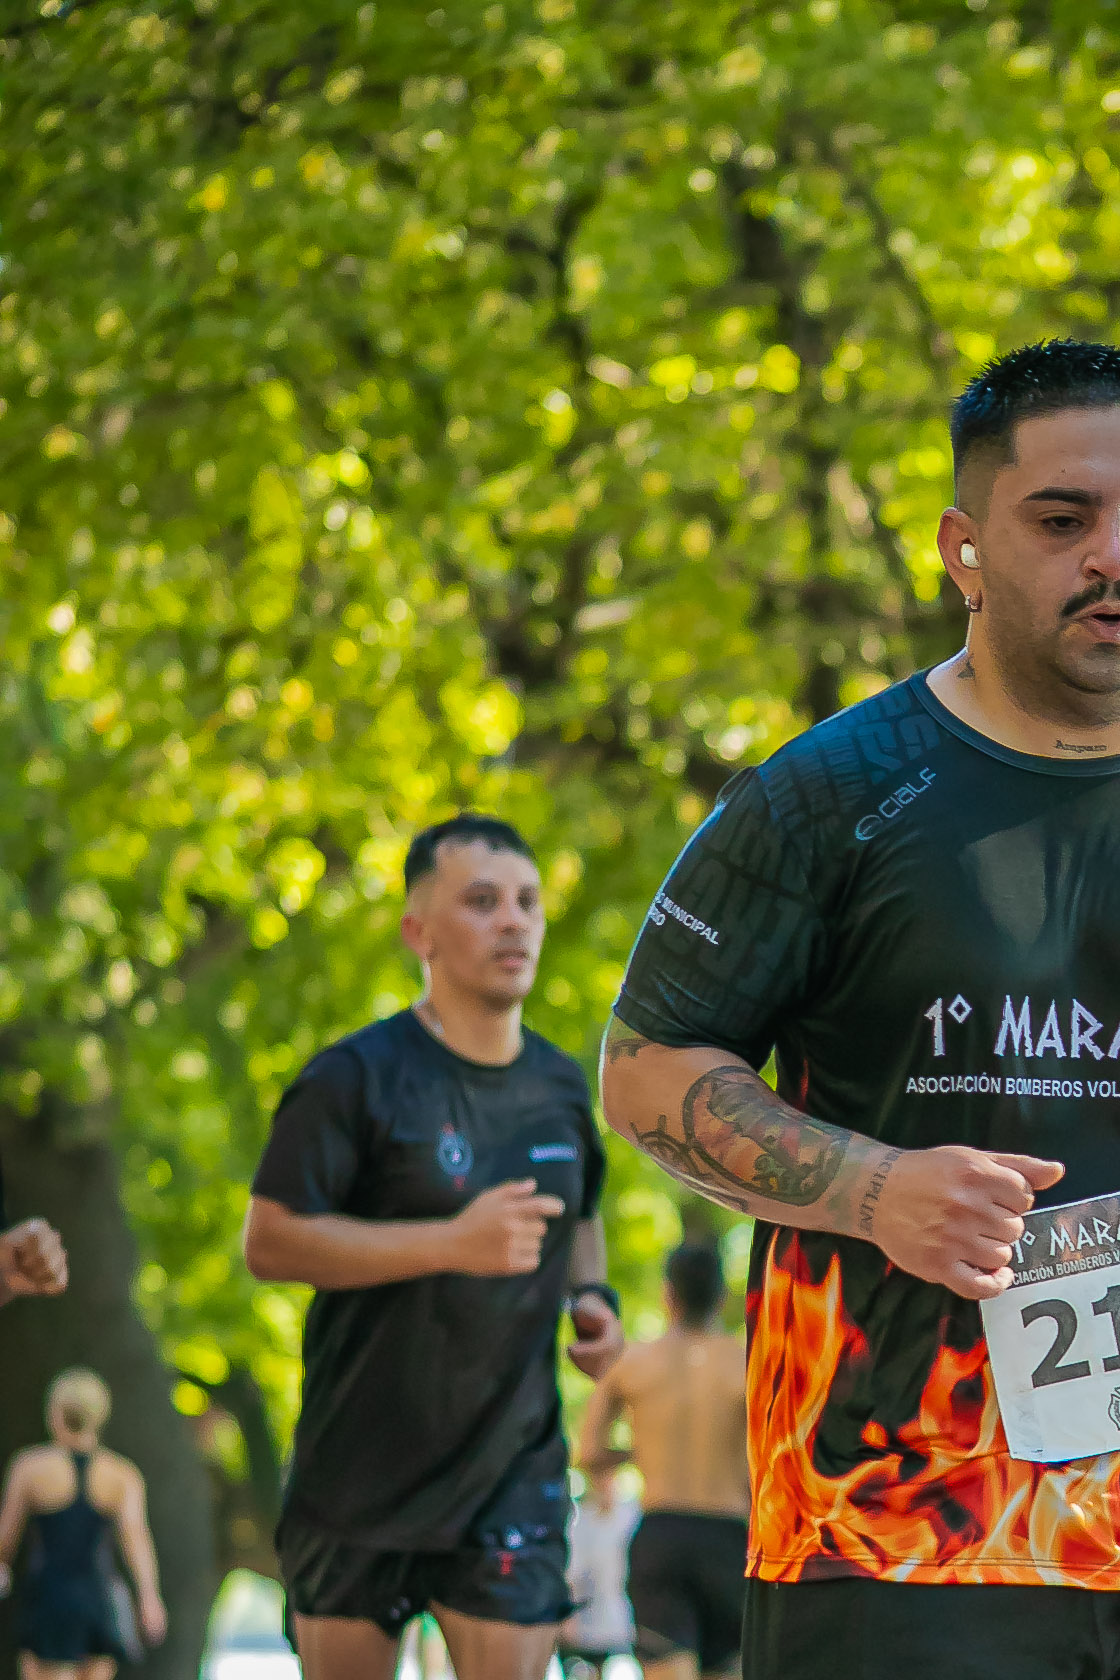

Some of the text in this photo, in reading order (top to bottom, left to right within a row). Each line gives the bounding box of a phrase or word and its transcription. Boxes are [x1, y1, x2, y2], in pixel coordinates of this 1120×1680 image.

[662, 896, 720, 946] MUNICIPAL
[905, 1072, 1002, 1094] ASOCIACIÓN
[1004, 1076, 1083, 1098] BOMBEROS
[1012, 1264, 1055, 1286] CIACIÓN
[1056, 1251, 1114, 1277] BOMBEROS
